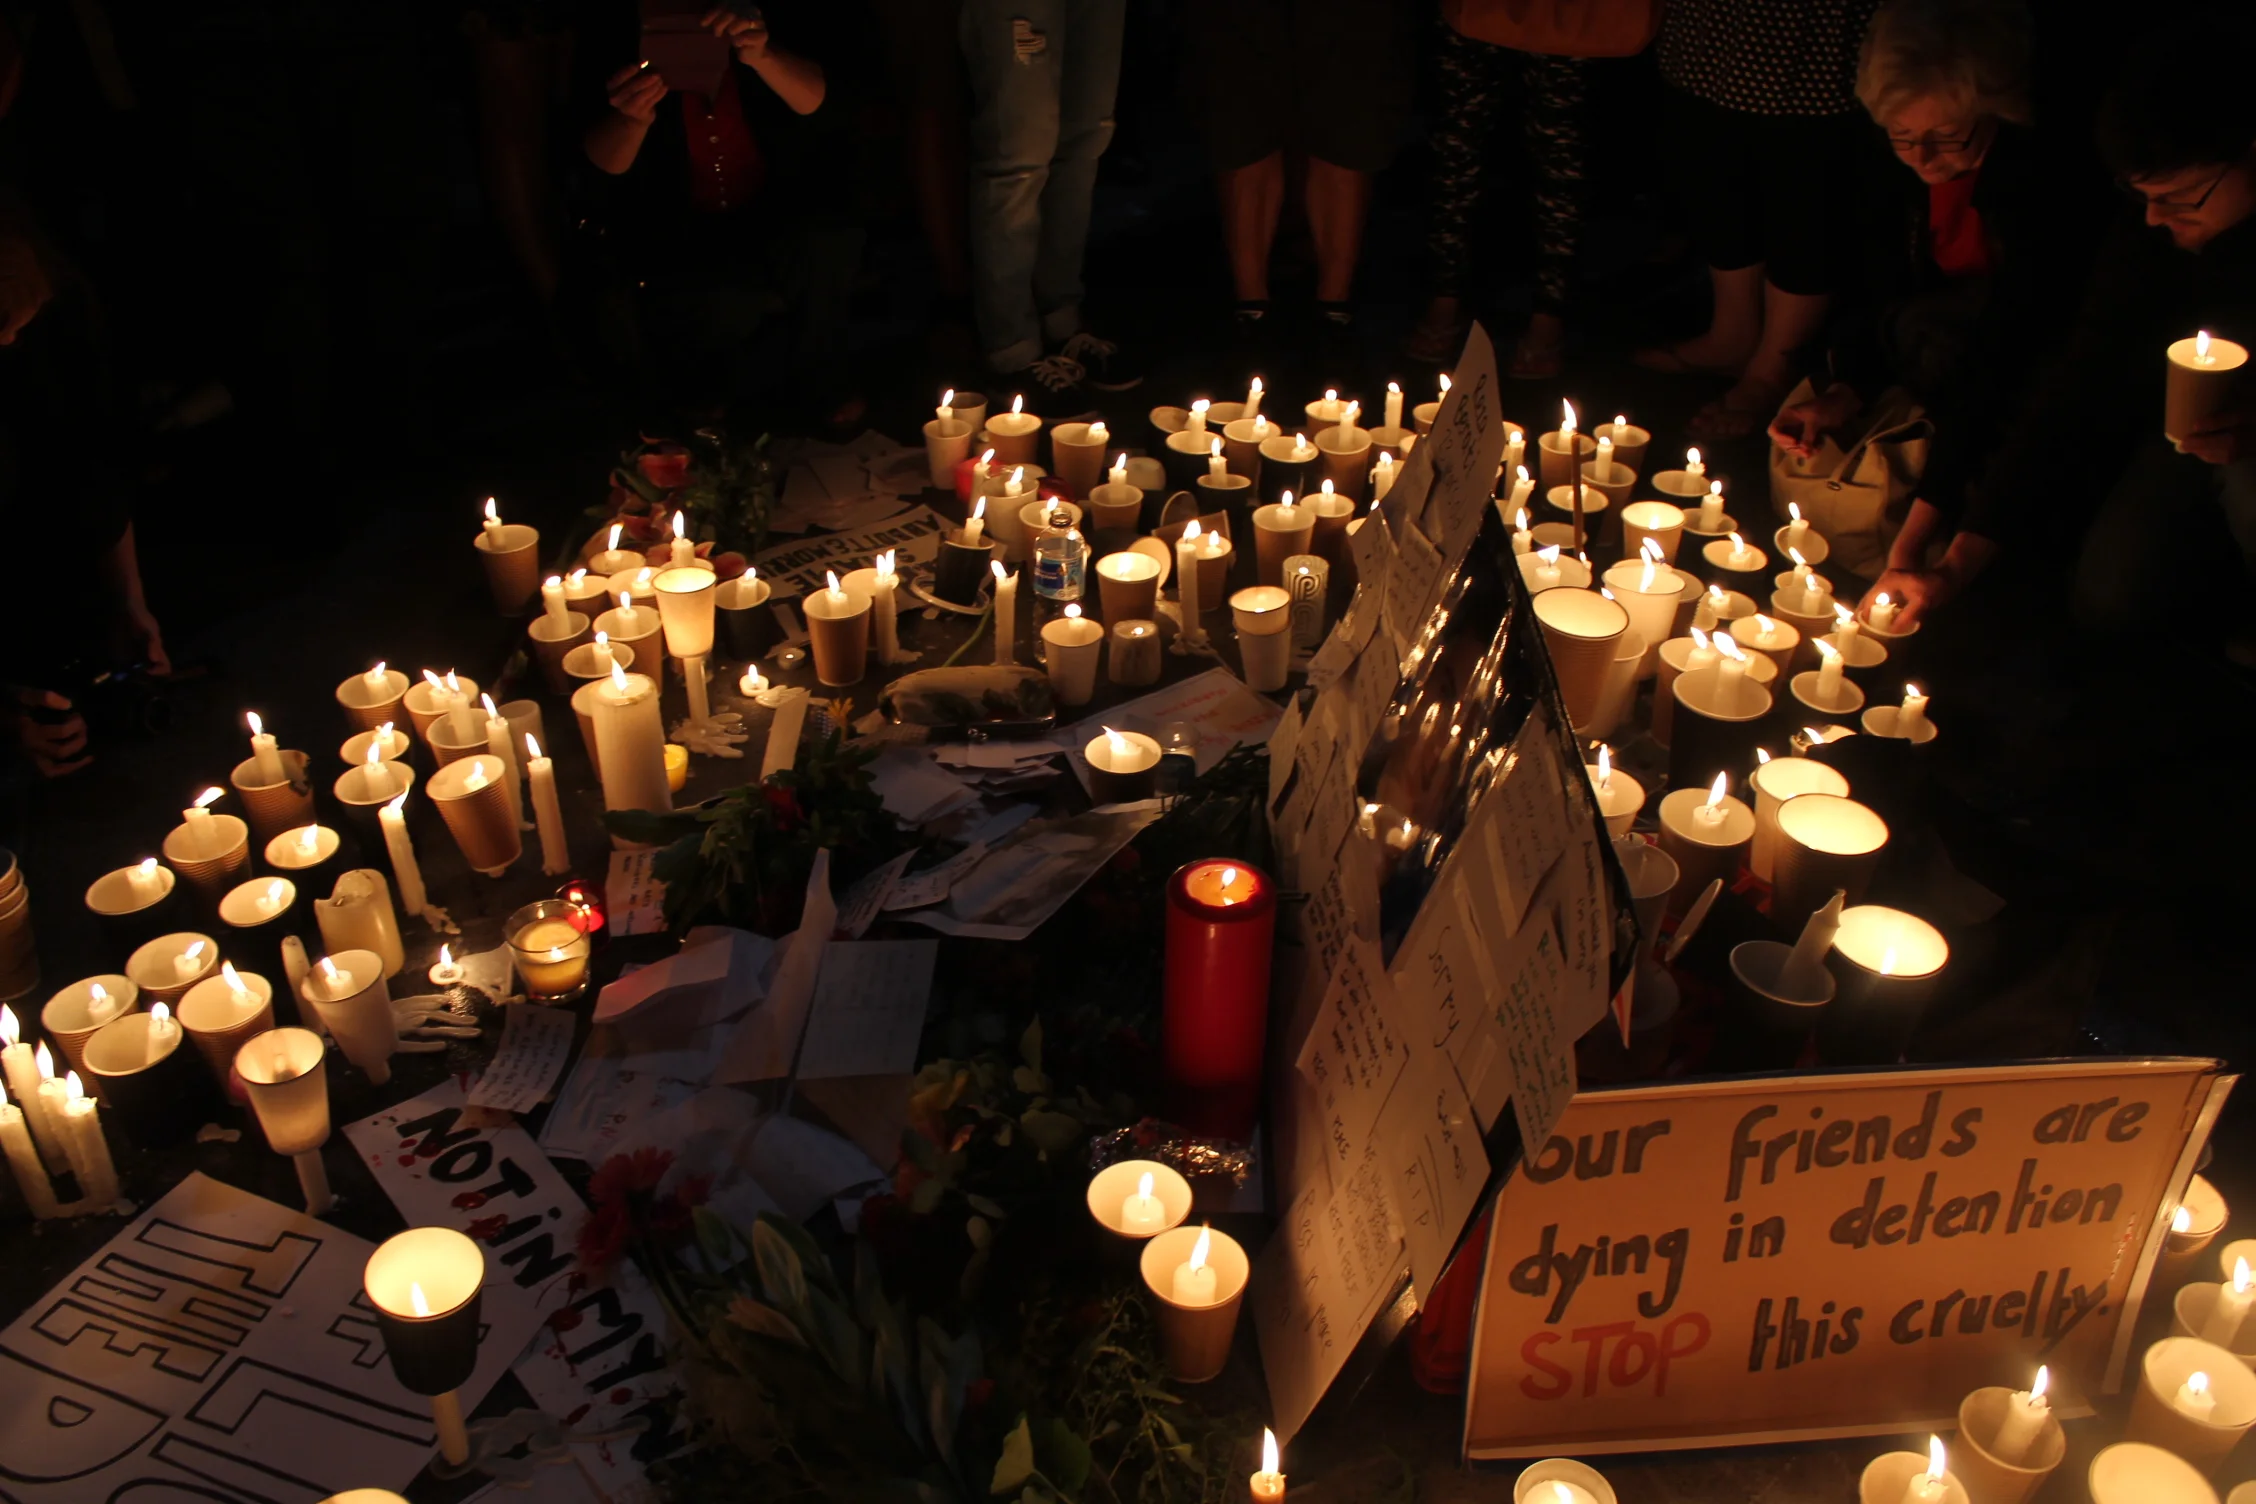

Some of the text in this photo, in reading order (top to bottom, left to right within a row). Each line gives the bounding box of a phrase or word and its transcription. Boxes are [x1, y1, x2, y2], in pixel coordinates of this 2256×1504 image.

[753, 544, 827, 582] MORRI
[1724, 1090, 1983, 1202] friends
[2033, 1096, 2150, 1145] are
[31, 1218, 323, 1383] THE
[396, 1107, 537, 1208] NOT
[545, 1288, 668, 1395] MY
[1508, 1158, 2123, 1324] dying in detention
[1519, 1267, 2108, 1400] STOP this cruelty.
